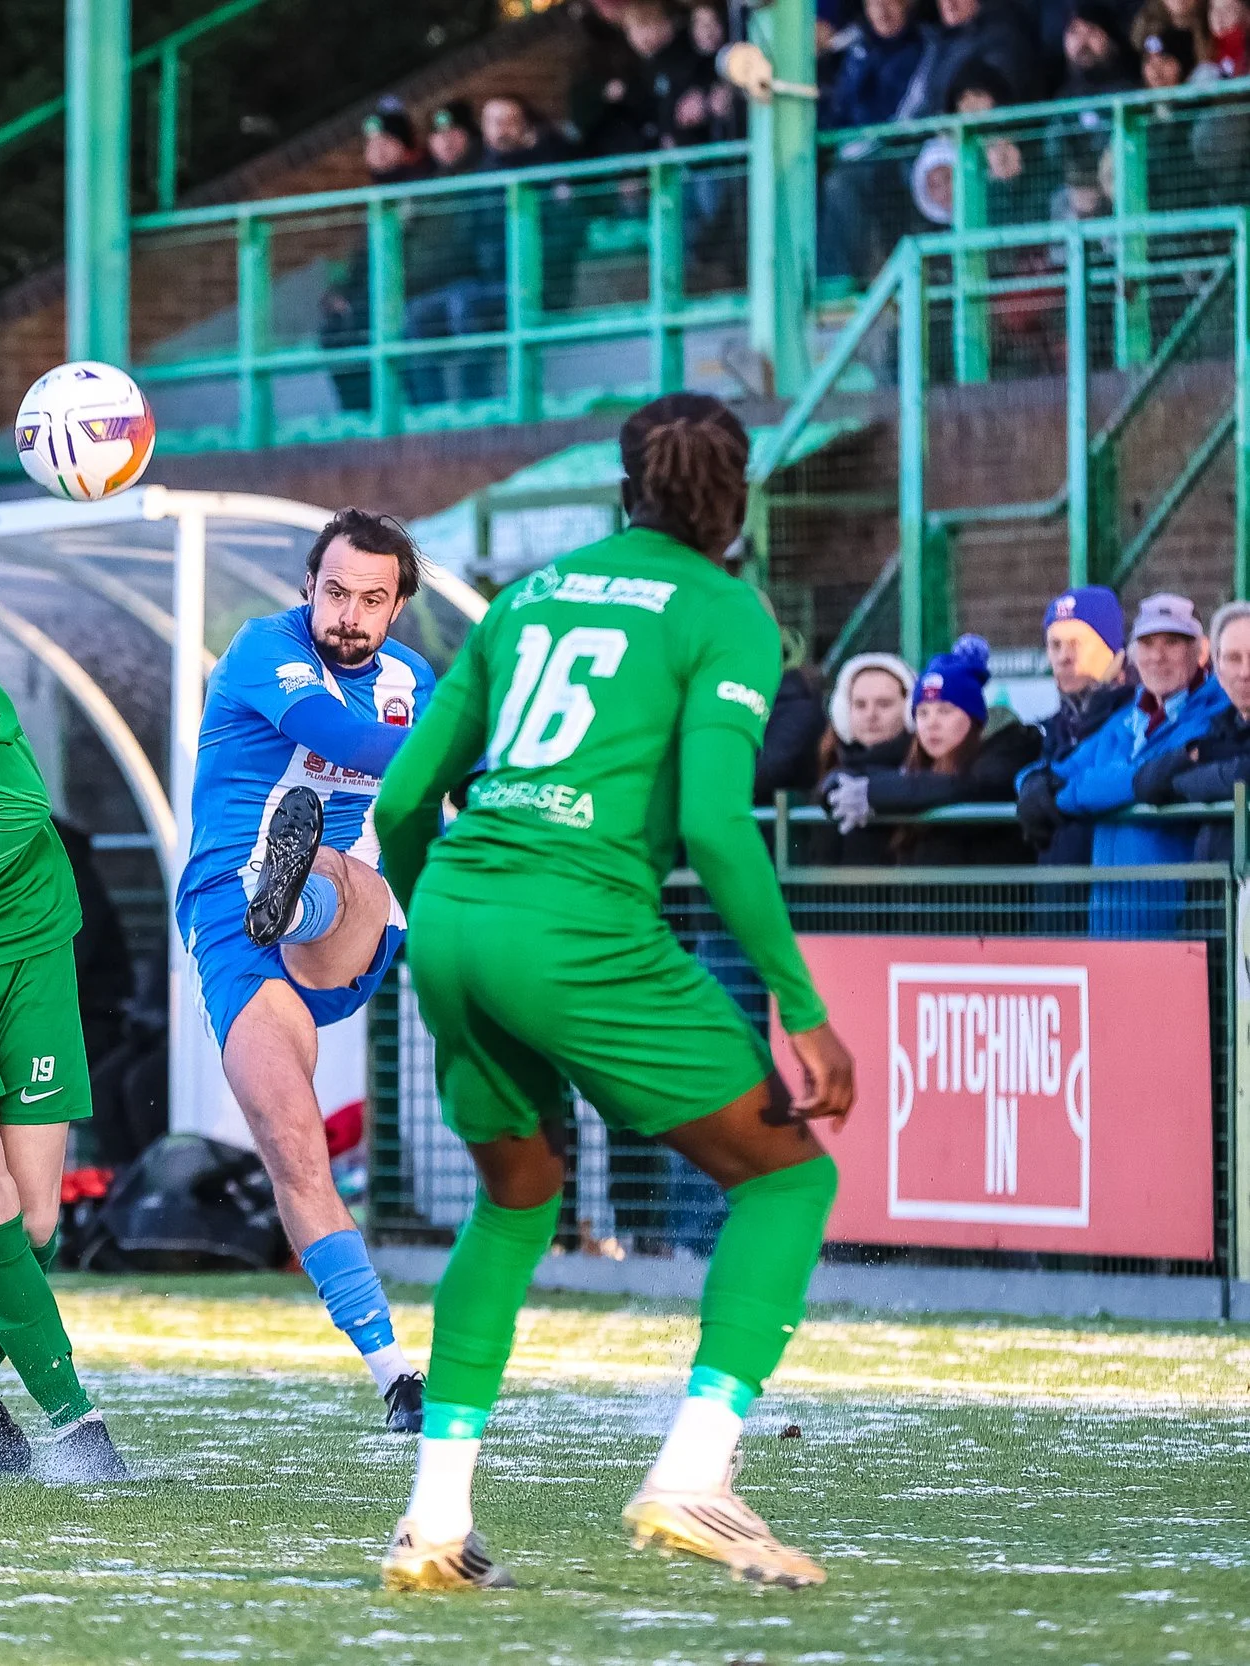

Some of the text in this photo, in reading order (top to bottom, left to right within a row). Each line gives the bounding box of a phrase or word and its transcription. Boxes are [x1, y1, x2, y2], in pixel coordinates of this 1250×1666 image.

[486, 623, 629, 772] 16
[305, 770, 342, 784] PLUMBING
[349, 779, 376, 787] HEATING
[30, 1056, 55, 1083] 19
[917, 992, 1062, 1097] PITCHING
[985, 1095, 1019, 1196] IN
